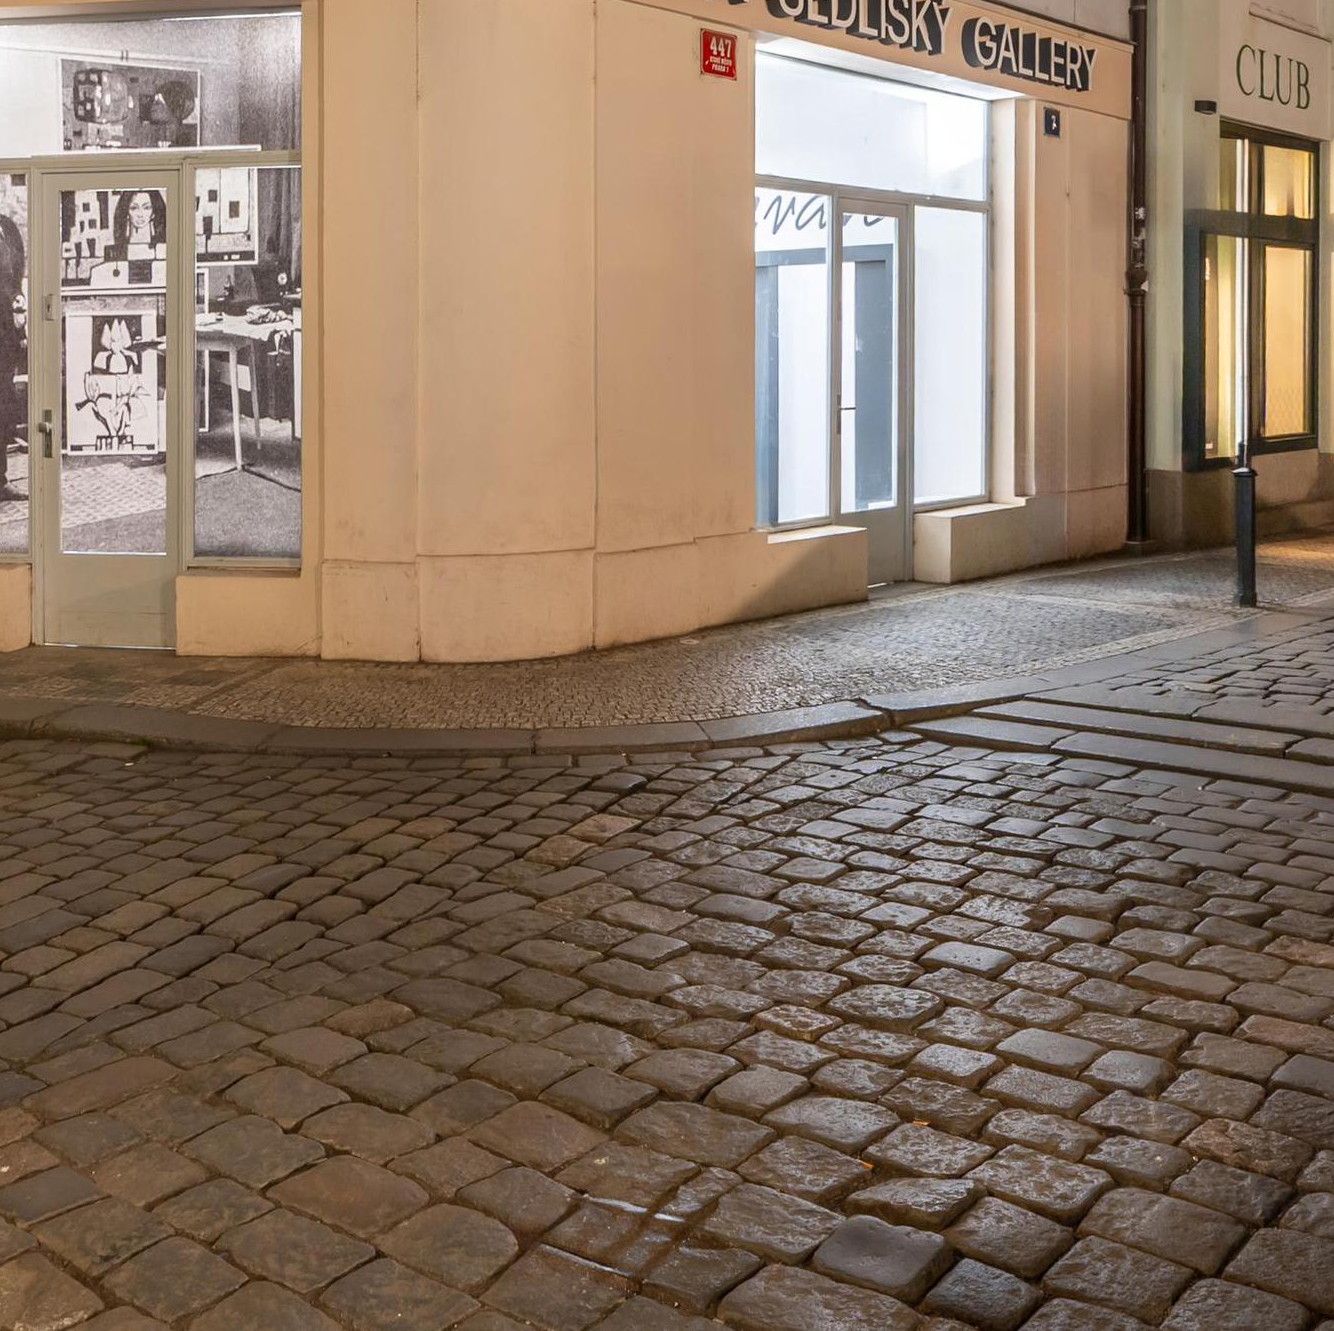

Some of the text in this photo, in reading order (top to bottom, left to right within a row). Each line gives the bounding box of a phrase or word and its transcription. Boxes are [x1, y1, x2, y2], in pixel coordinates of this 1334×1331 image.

[709, 36, 732, 58] 447
[962, 16, 1097, 92] GALLERY
[1235, 44, 1311, 110] CLUB
